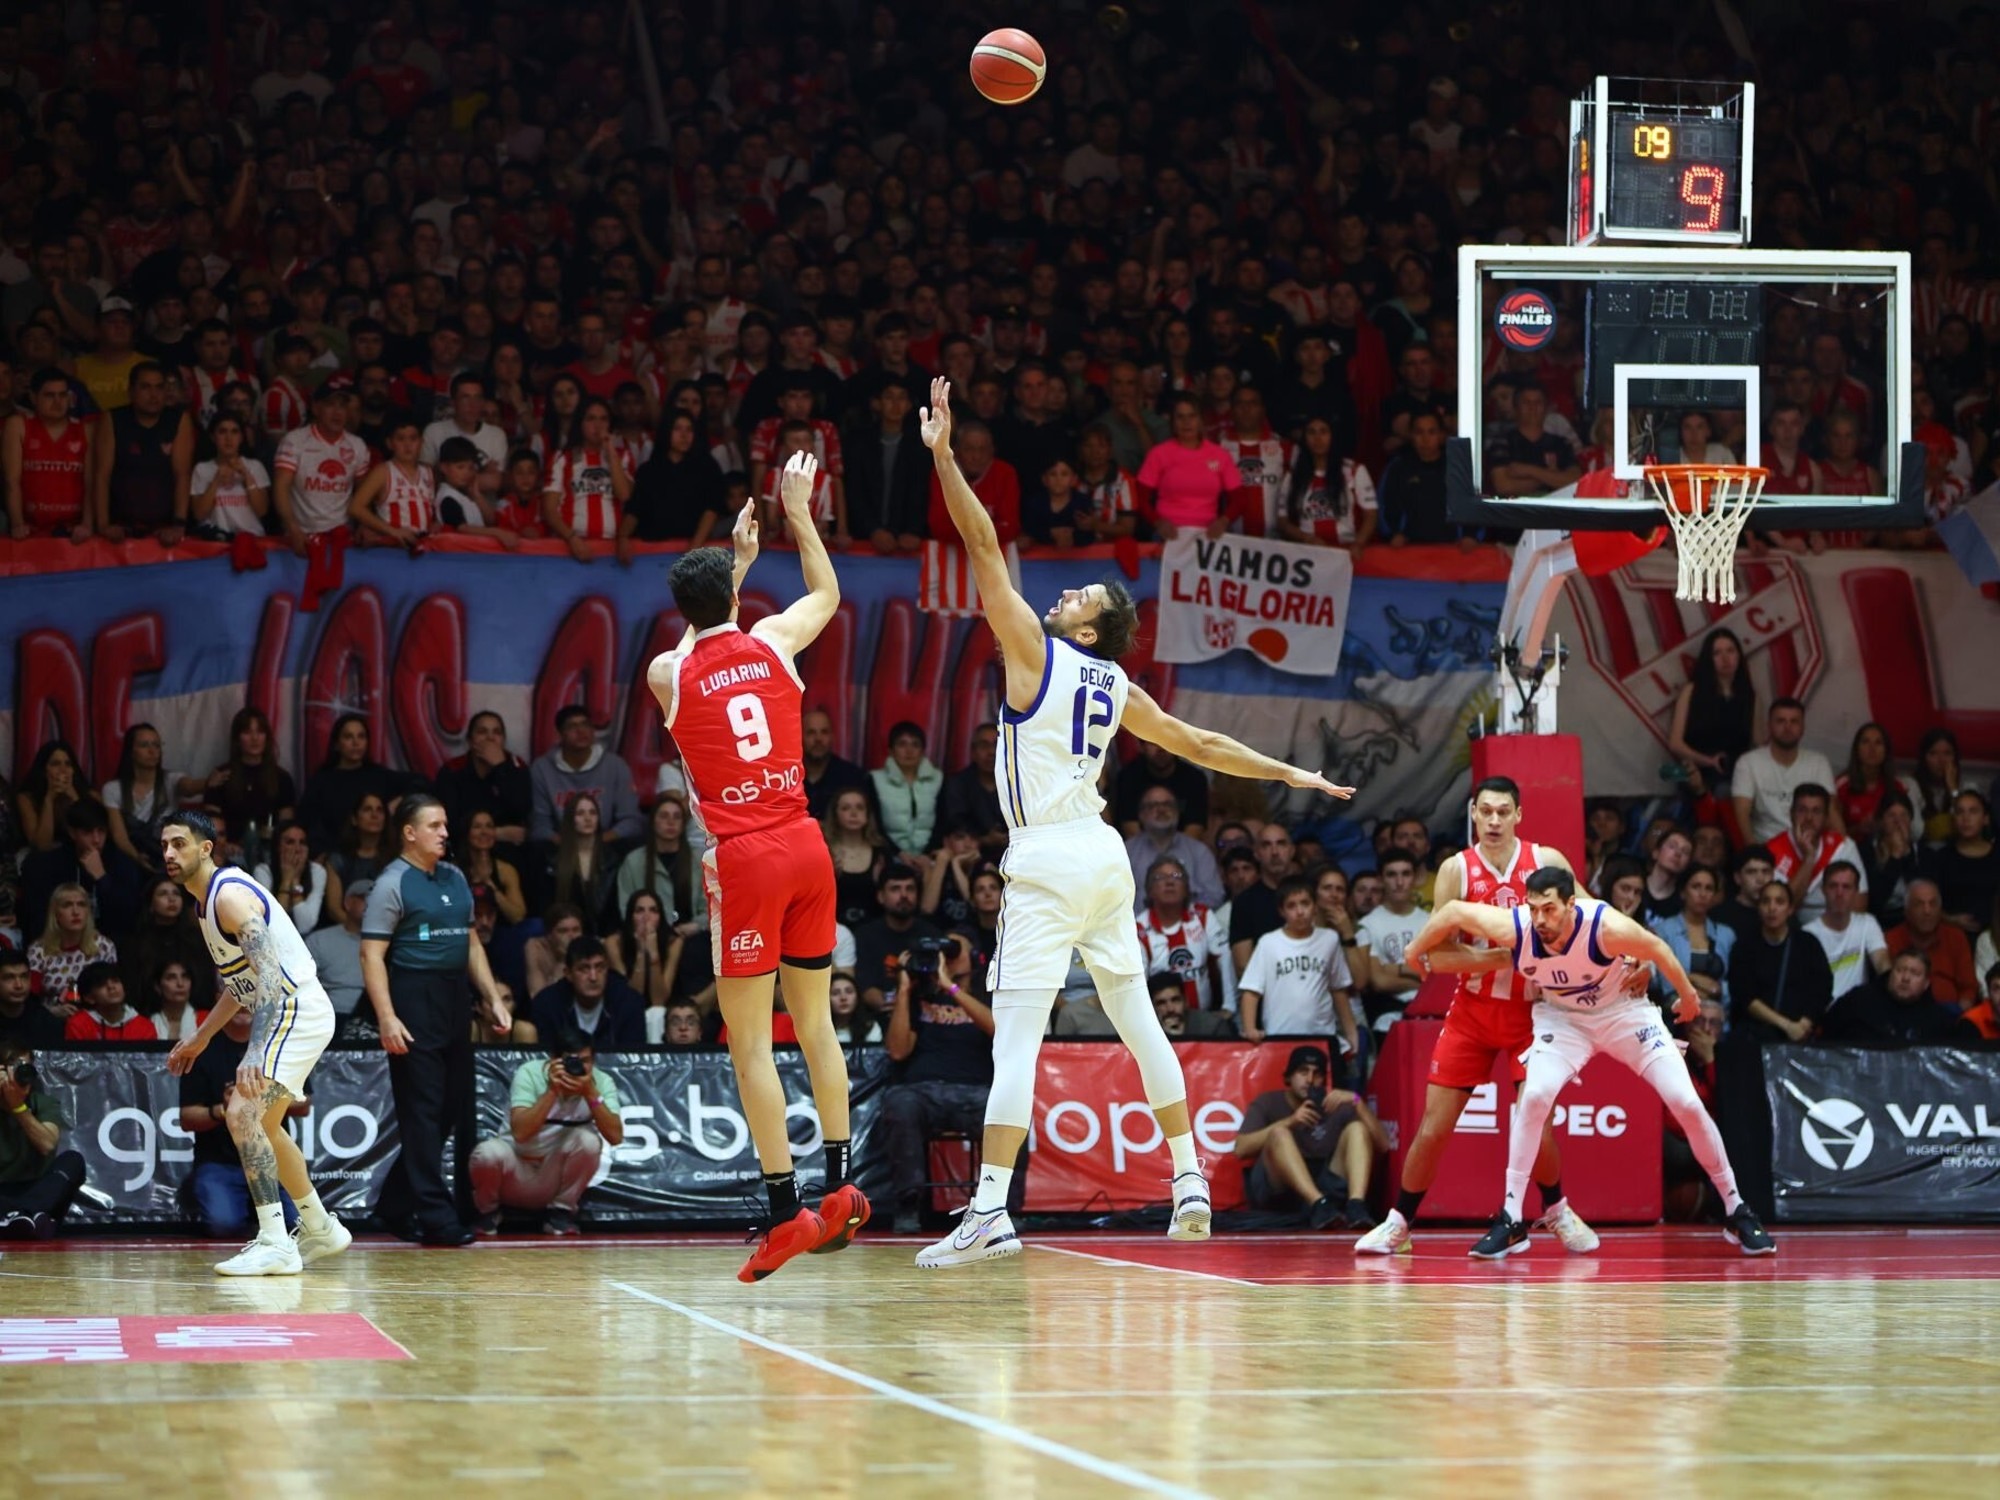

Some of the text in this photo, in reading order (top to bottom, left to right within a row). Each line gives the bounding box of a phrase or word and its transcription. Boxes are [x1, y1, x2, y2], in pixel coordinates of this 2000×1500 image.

[1633, 125, 1671, 159] 09
[1682, 165, 1724, 232] 9
[1498, 313, 1553, 326] FINALES
[1196, 538, 1314, 588] VAMOS
[700, 661, 771, 697] LUGARINI
[725, 692, 773, 763] 9
[1071, 685, 1114, 760] 12
[730, 932, 764, 951] GEA
[1551, 969, 1569, 985] 10
[693, 1170, 738, 1181] Calidad
